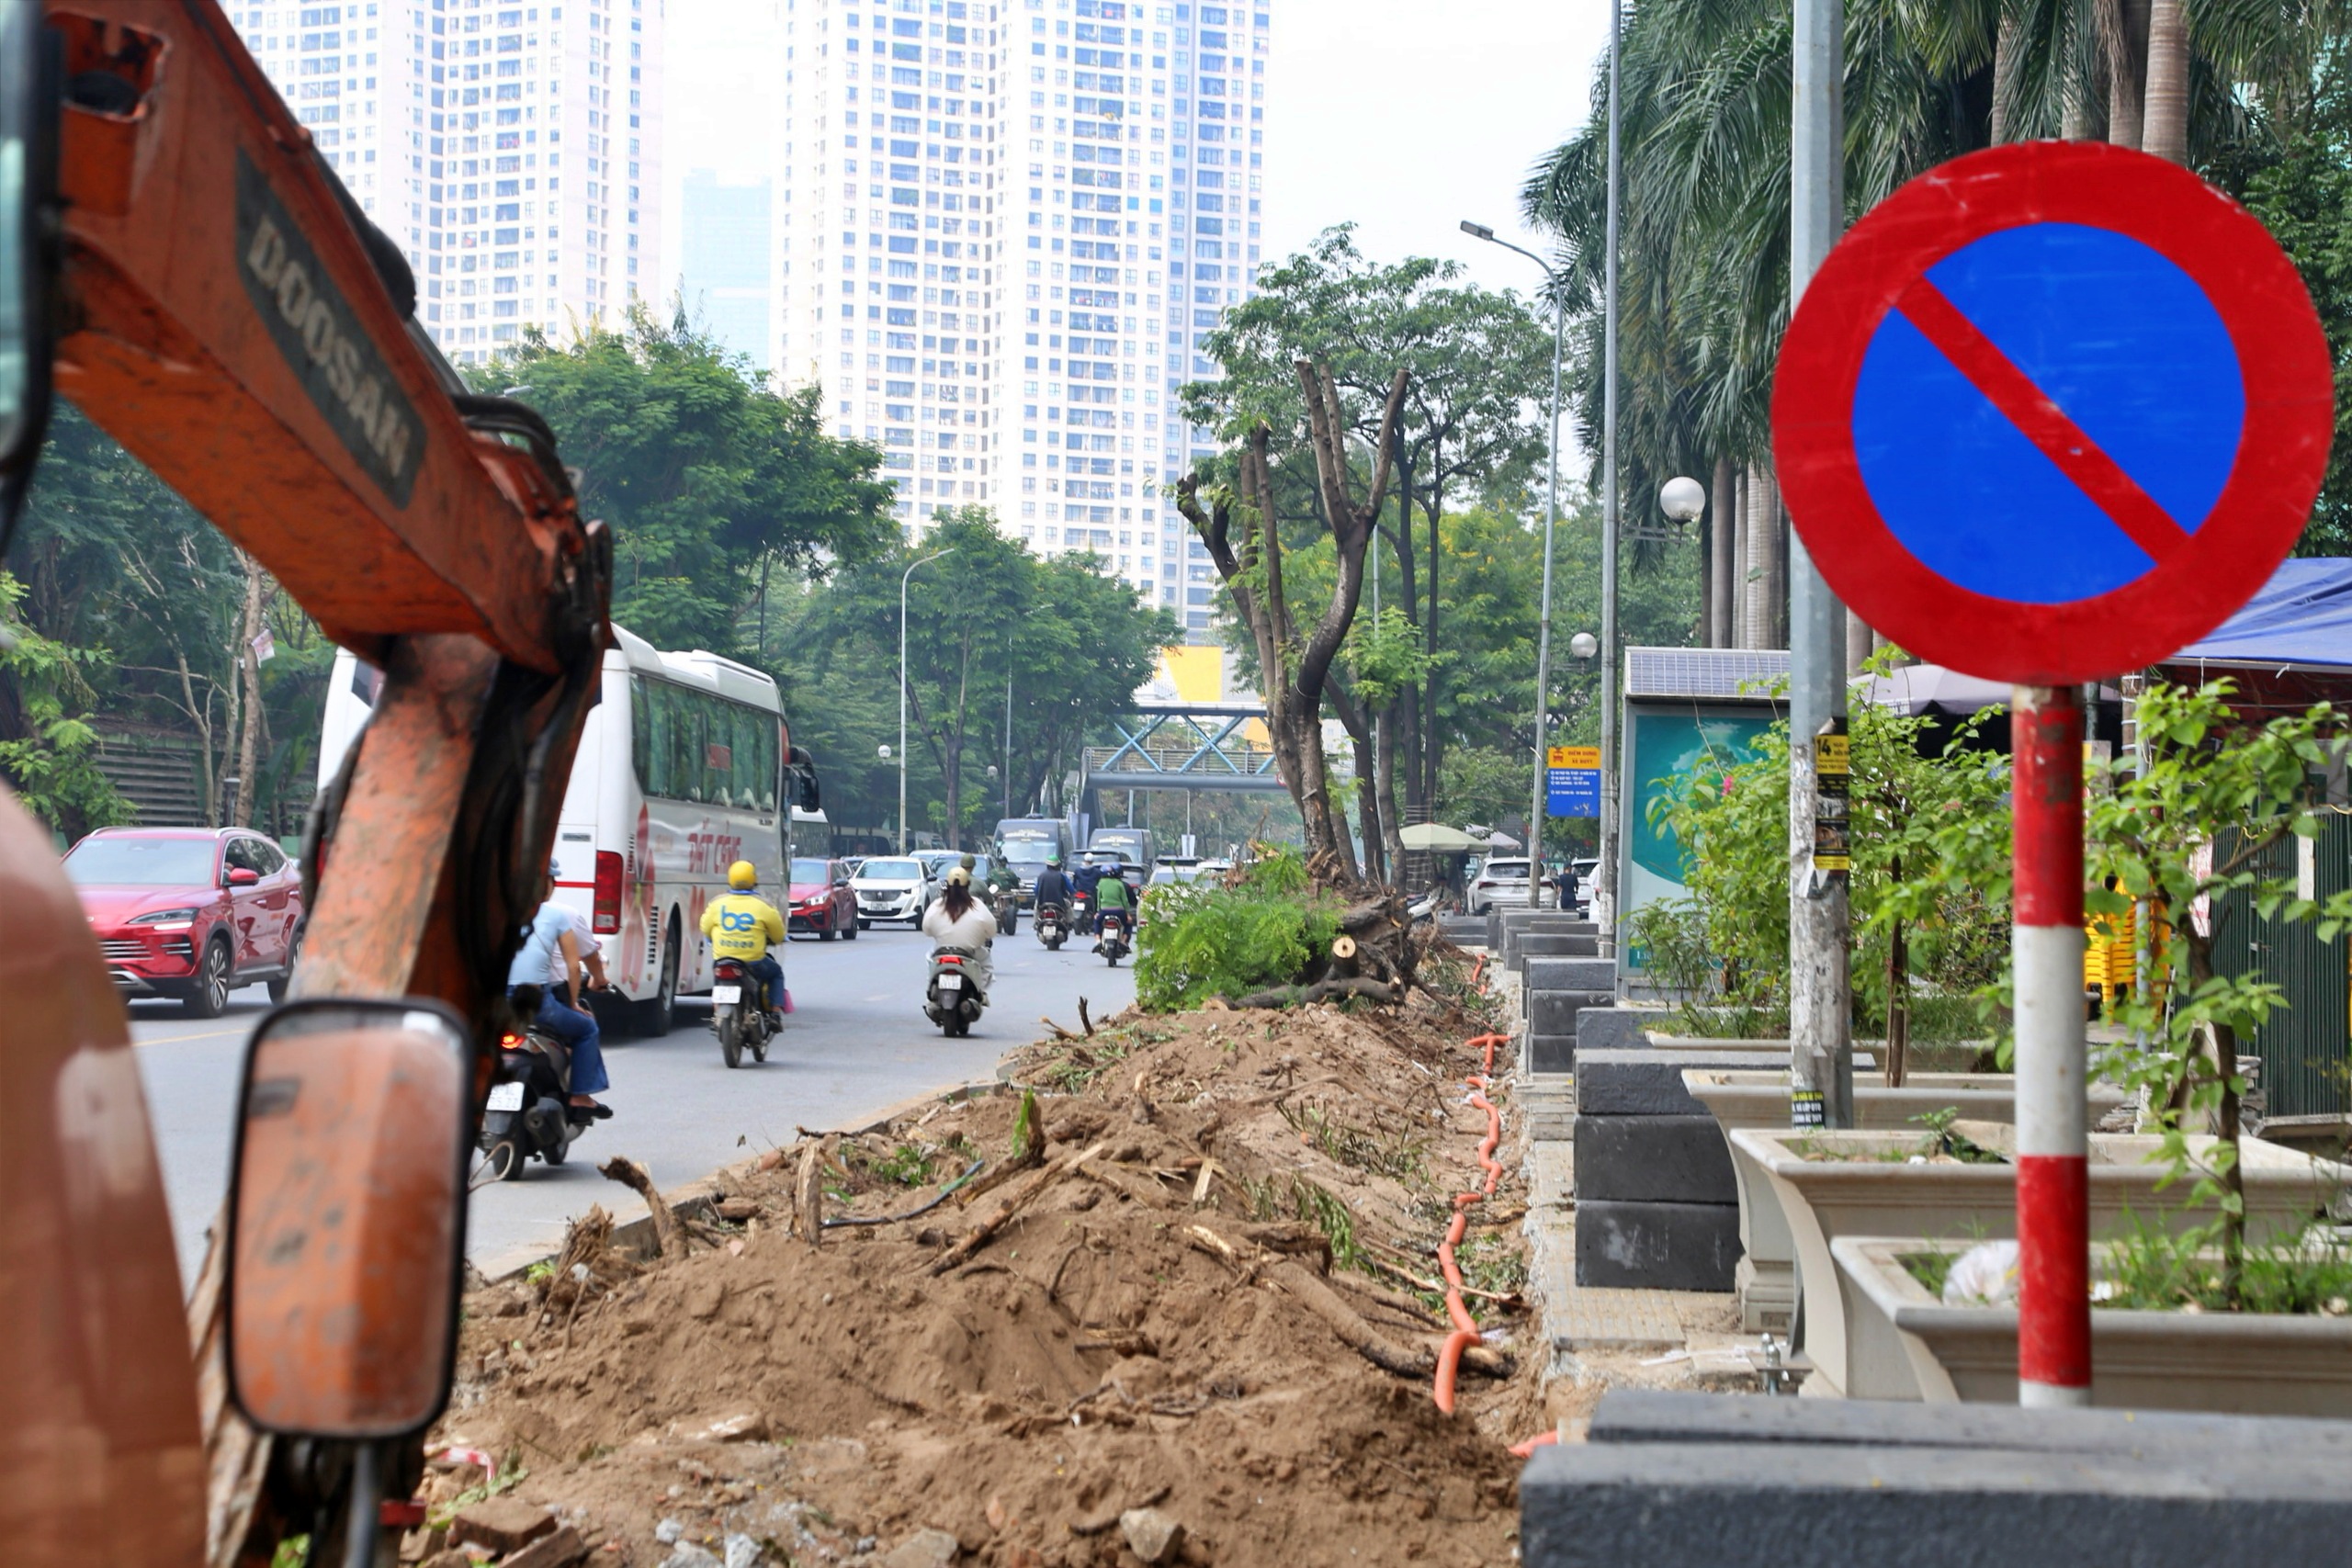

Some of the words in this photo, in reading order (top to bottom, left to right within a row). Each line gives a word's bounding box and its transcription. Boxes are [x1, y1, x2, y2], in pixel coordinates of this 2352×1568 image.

[247, 214, 410, 478] DOOSAN
[1816, 739, 1832, 756] 14
[720, 905, 755, 931] be
